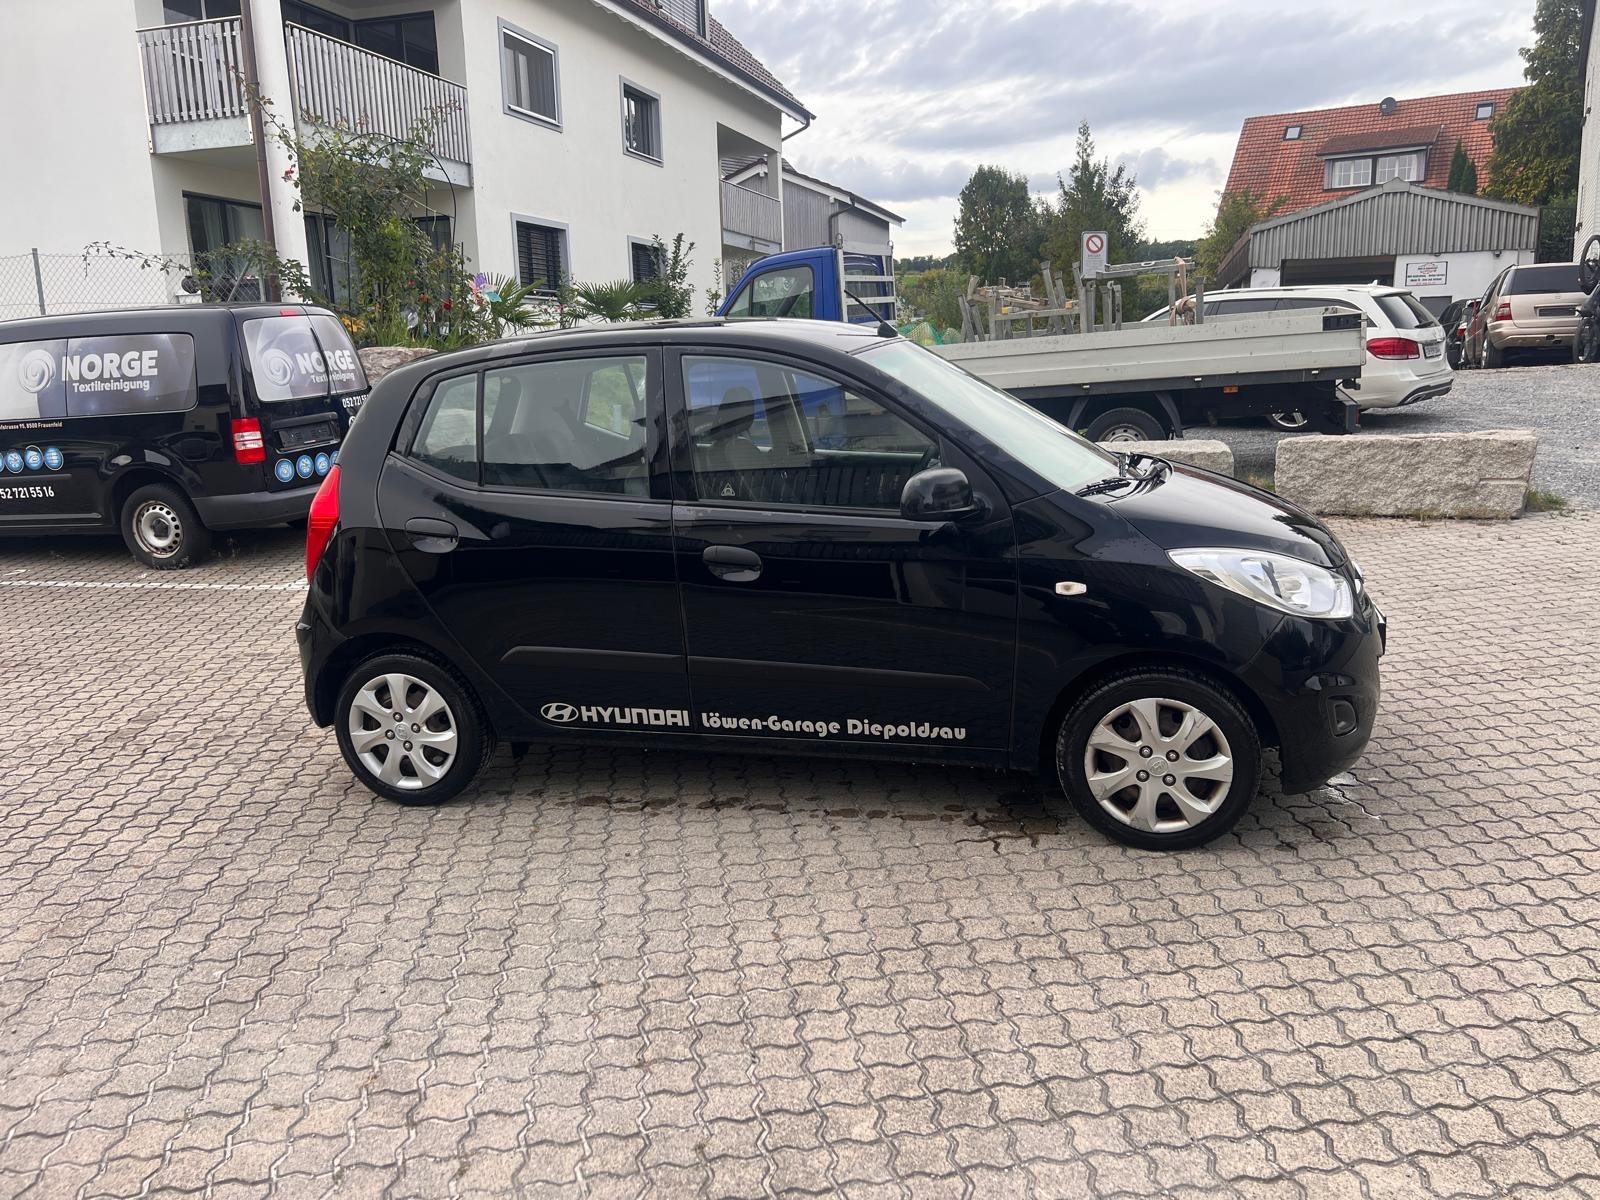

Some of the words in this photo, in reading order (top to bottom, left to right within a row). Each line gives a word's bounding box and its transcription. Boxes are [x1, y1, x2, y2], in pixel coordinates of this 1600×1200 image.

[61, 350, 158, 381] NORGE
[295, 350, 355, 374] NORGE
[72, 379, 150, 392] Textilreinigung
[342, 398, 354, 408] 052
[12, 487, 29, 499] 721
[29, 486, 43, 498] 55
[43, 485, 54, 498] 16
[580, 705, 690, 727] HYUNDAI
[701, 712, 841, 737] Löwen-Garage
[846, 719, 966, 740] Diepoldsau
